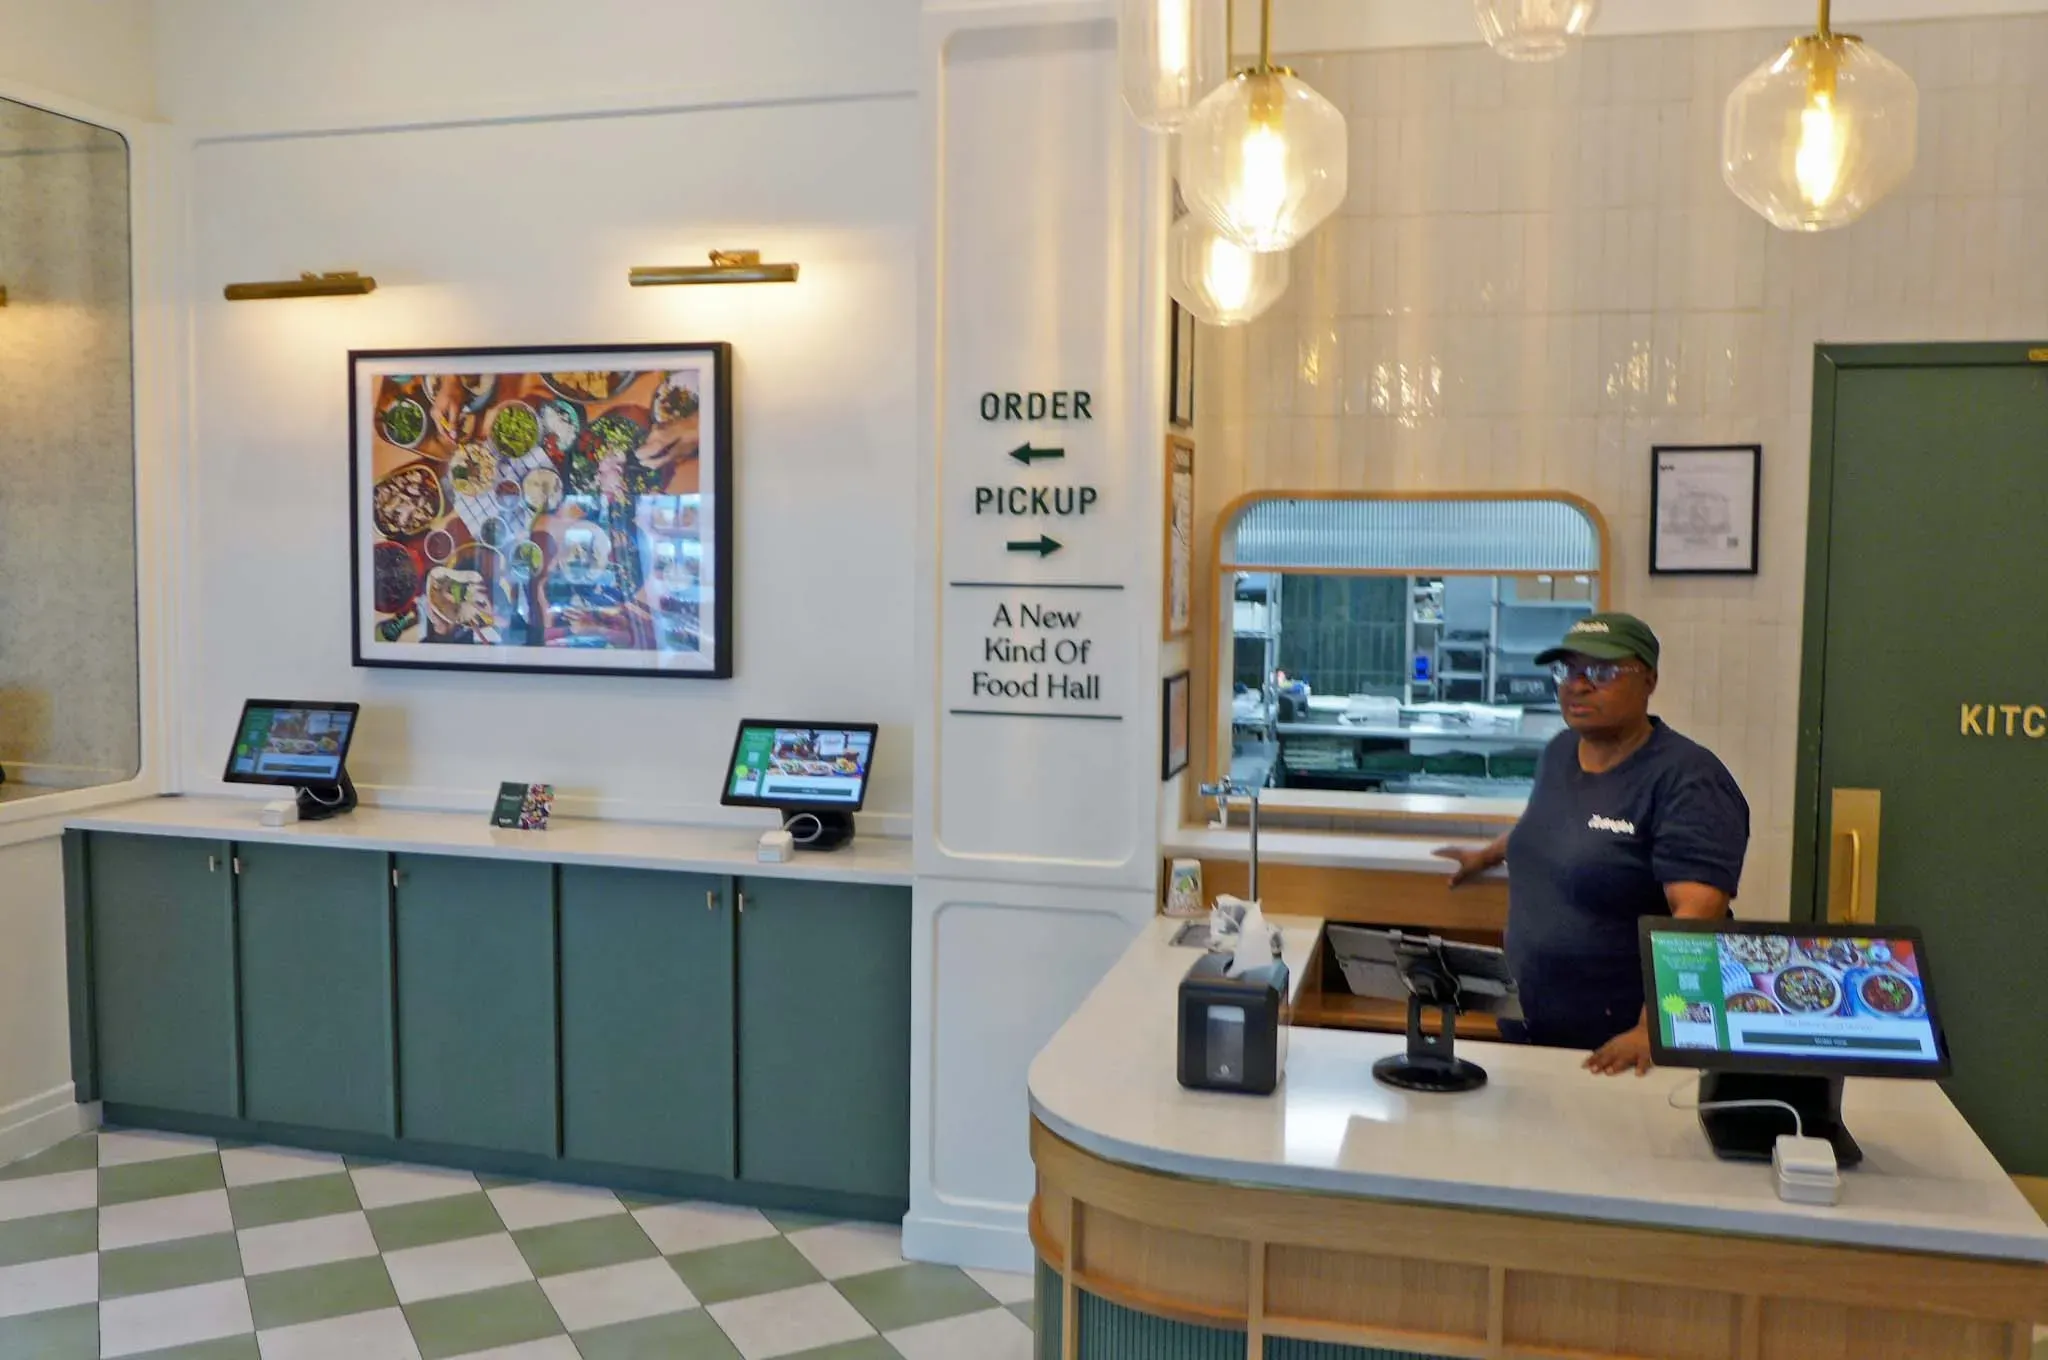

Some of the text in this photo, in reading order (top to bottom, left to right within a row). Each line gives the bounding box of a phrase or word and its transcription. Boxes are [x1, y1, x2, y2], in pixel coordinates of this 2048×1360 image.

[980, 391, 1093, 421] ORDER
[975, 486, 1098, 516] PICKUP
[992, 602, 1082, 629] A New
[985, 637, 1092, 665] Kind Of
[972, 671, 1100, 700] Food Hall
